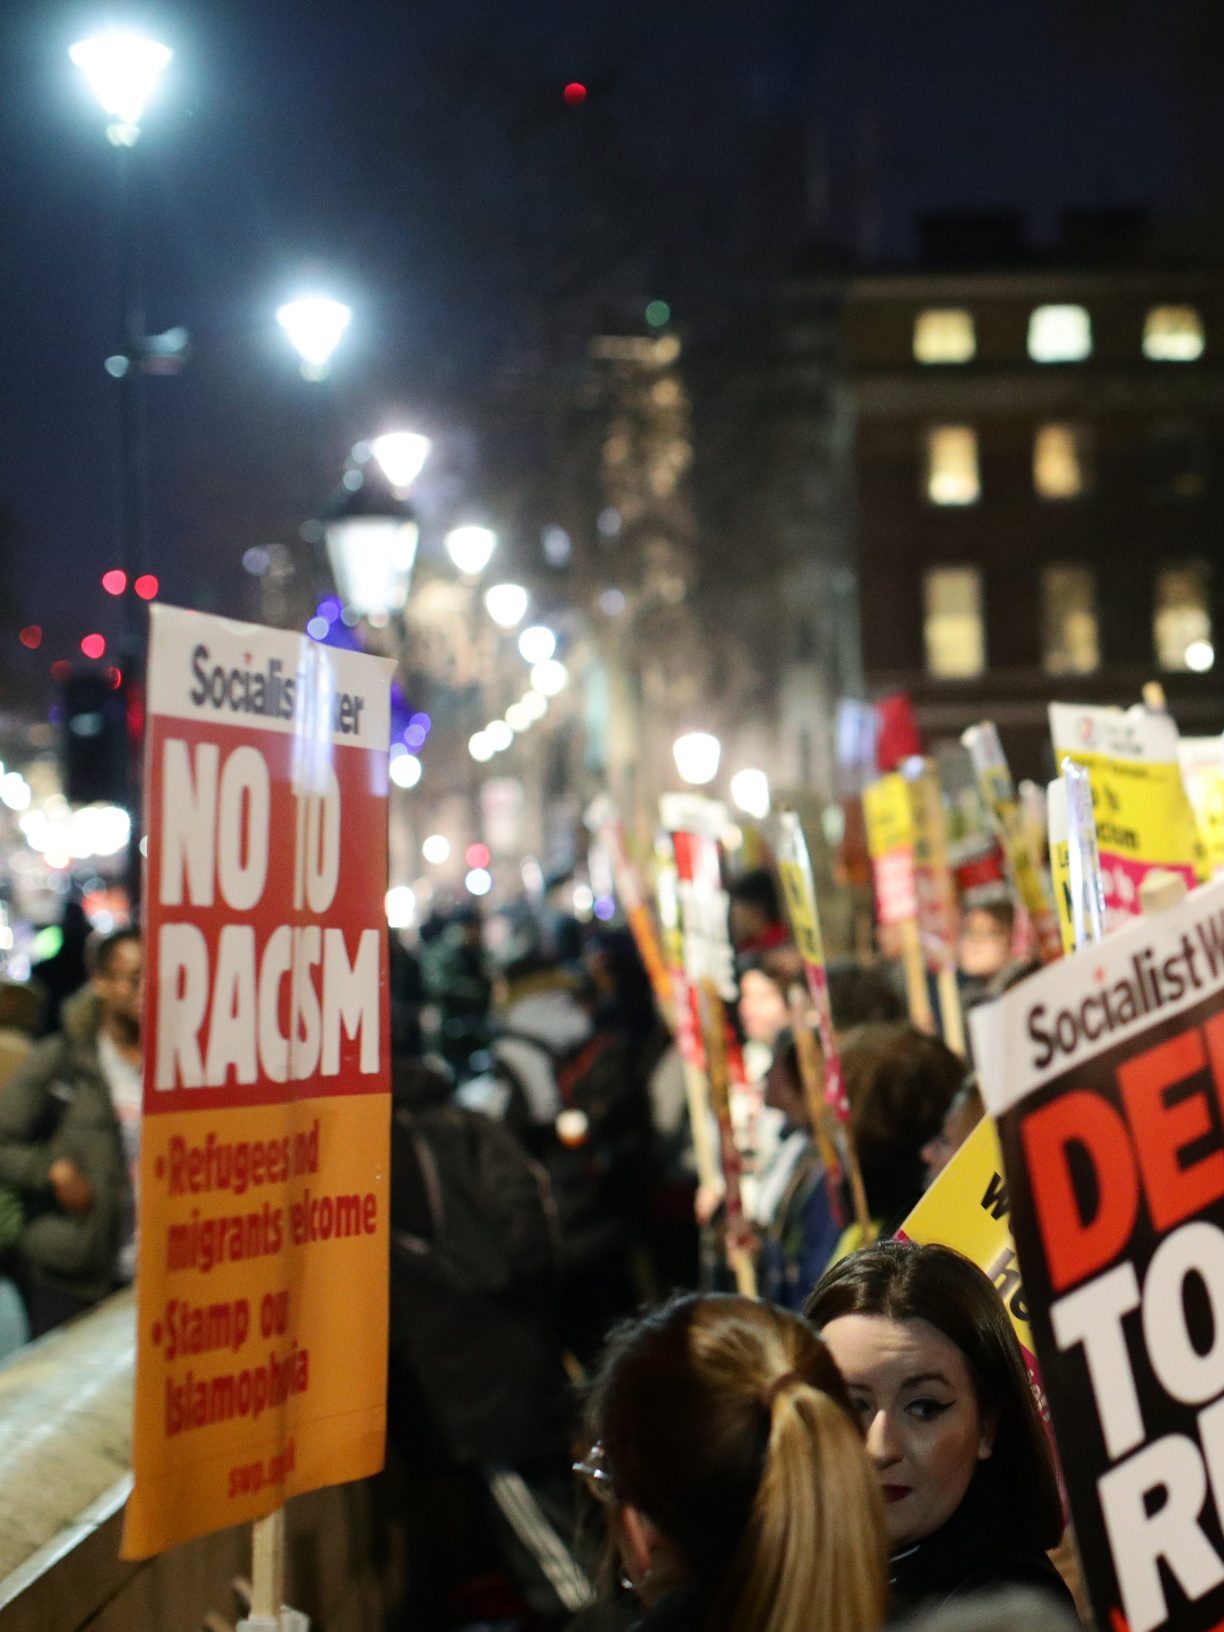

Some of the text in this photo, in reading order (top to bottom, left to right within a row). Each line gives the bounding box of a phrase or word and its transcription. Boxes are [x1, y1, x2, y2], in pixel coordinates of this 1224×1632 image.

[160, 738, 270, 911] NO
[155, 922, 380, 1091] RACISM
[169, 1132, 290, 1197] Refugees
[164, 1201, 283, 1274] migrants
[165, 1297, 249, 1362] Stamp
